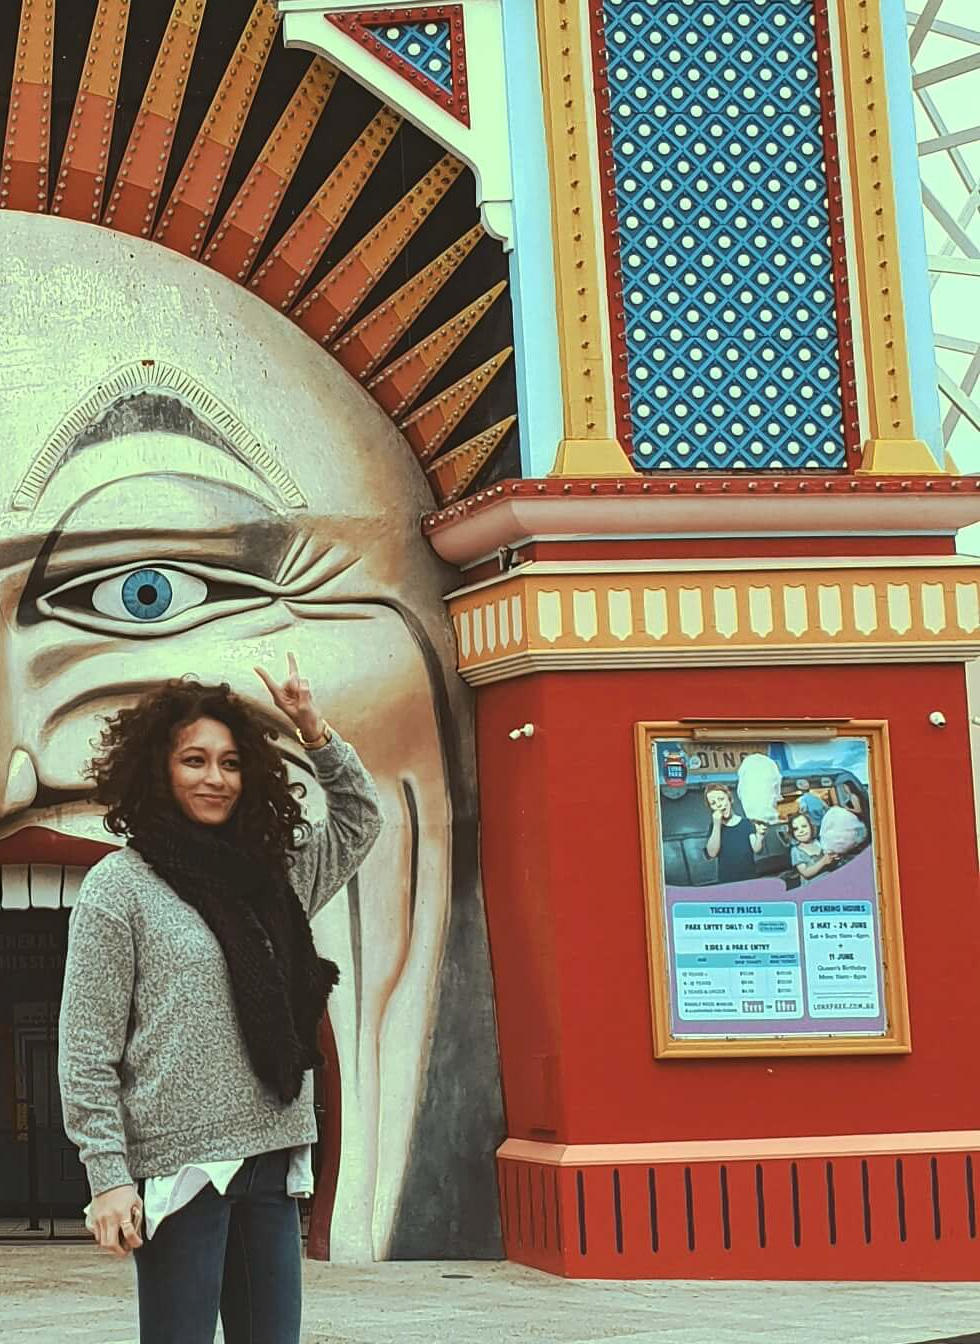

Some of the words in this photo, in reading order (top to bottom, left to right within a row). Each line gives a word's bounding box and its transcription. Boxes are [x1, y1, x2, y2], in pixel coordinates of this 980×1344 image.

[710, 906, 735, 914] TICKET
[737, 906, 762, 914] PRICES
[810, 905, 841, 913] OPENING
[703, 923, 723, 931] ENTRY
